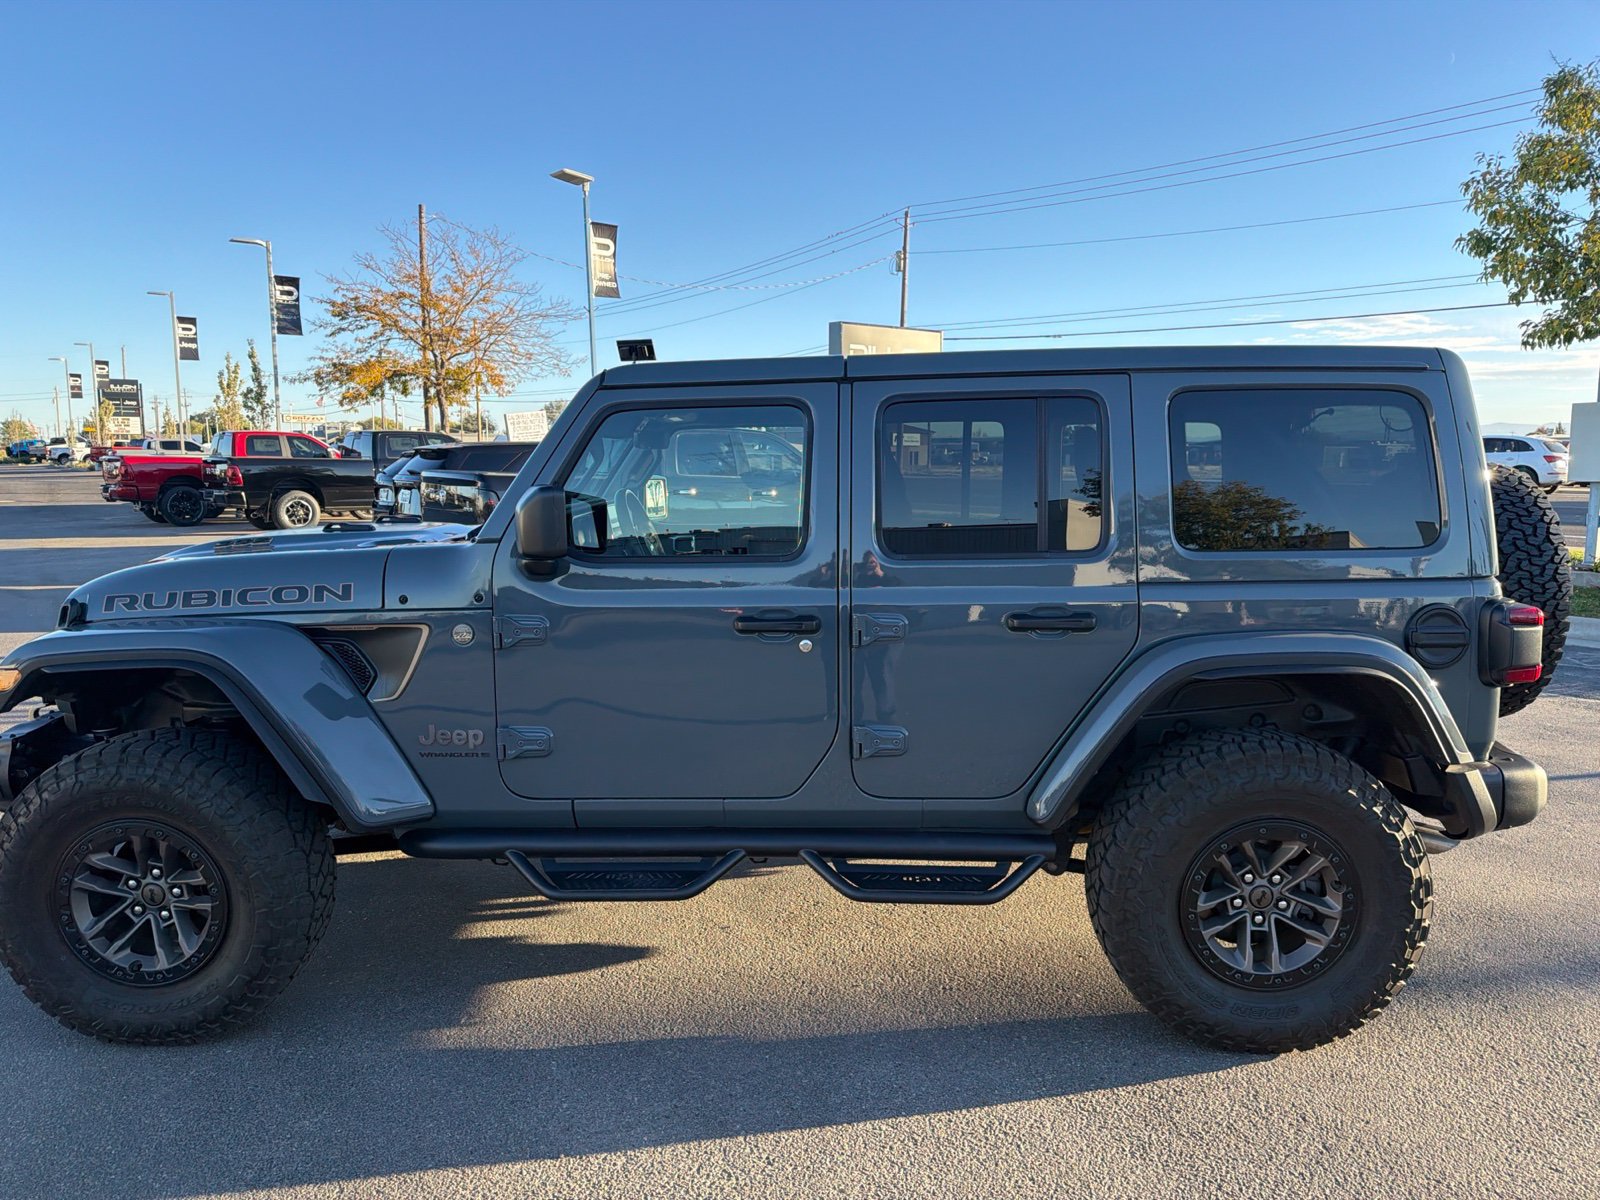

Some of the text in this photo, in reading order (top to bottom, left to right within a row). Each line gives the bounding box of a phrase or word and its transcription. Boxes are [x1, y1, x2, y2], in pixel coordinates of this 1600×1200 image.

[179, 341, 198, 350] Jeep
[103, 583, 354, 613] RUBICON
[418, 723, 485, 750] Jeep
[419, 751, 479, 759] WRANGLER
